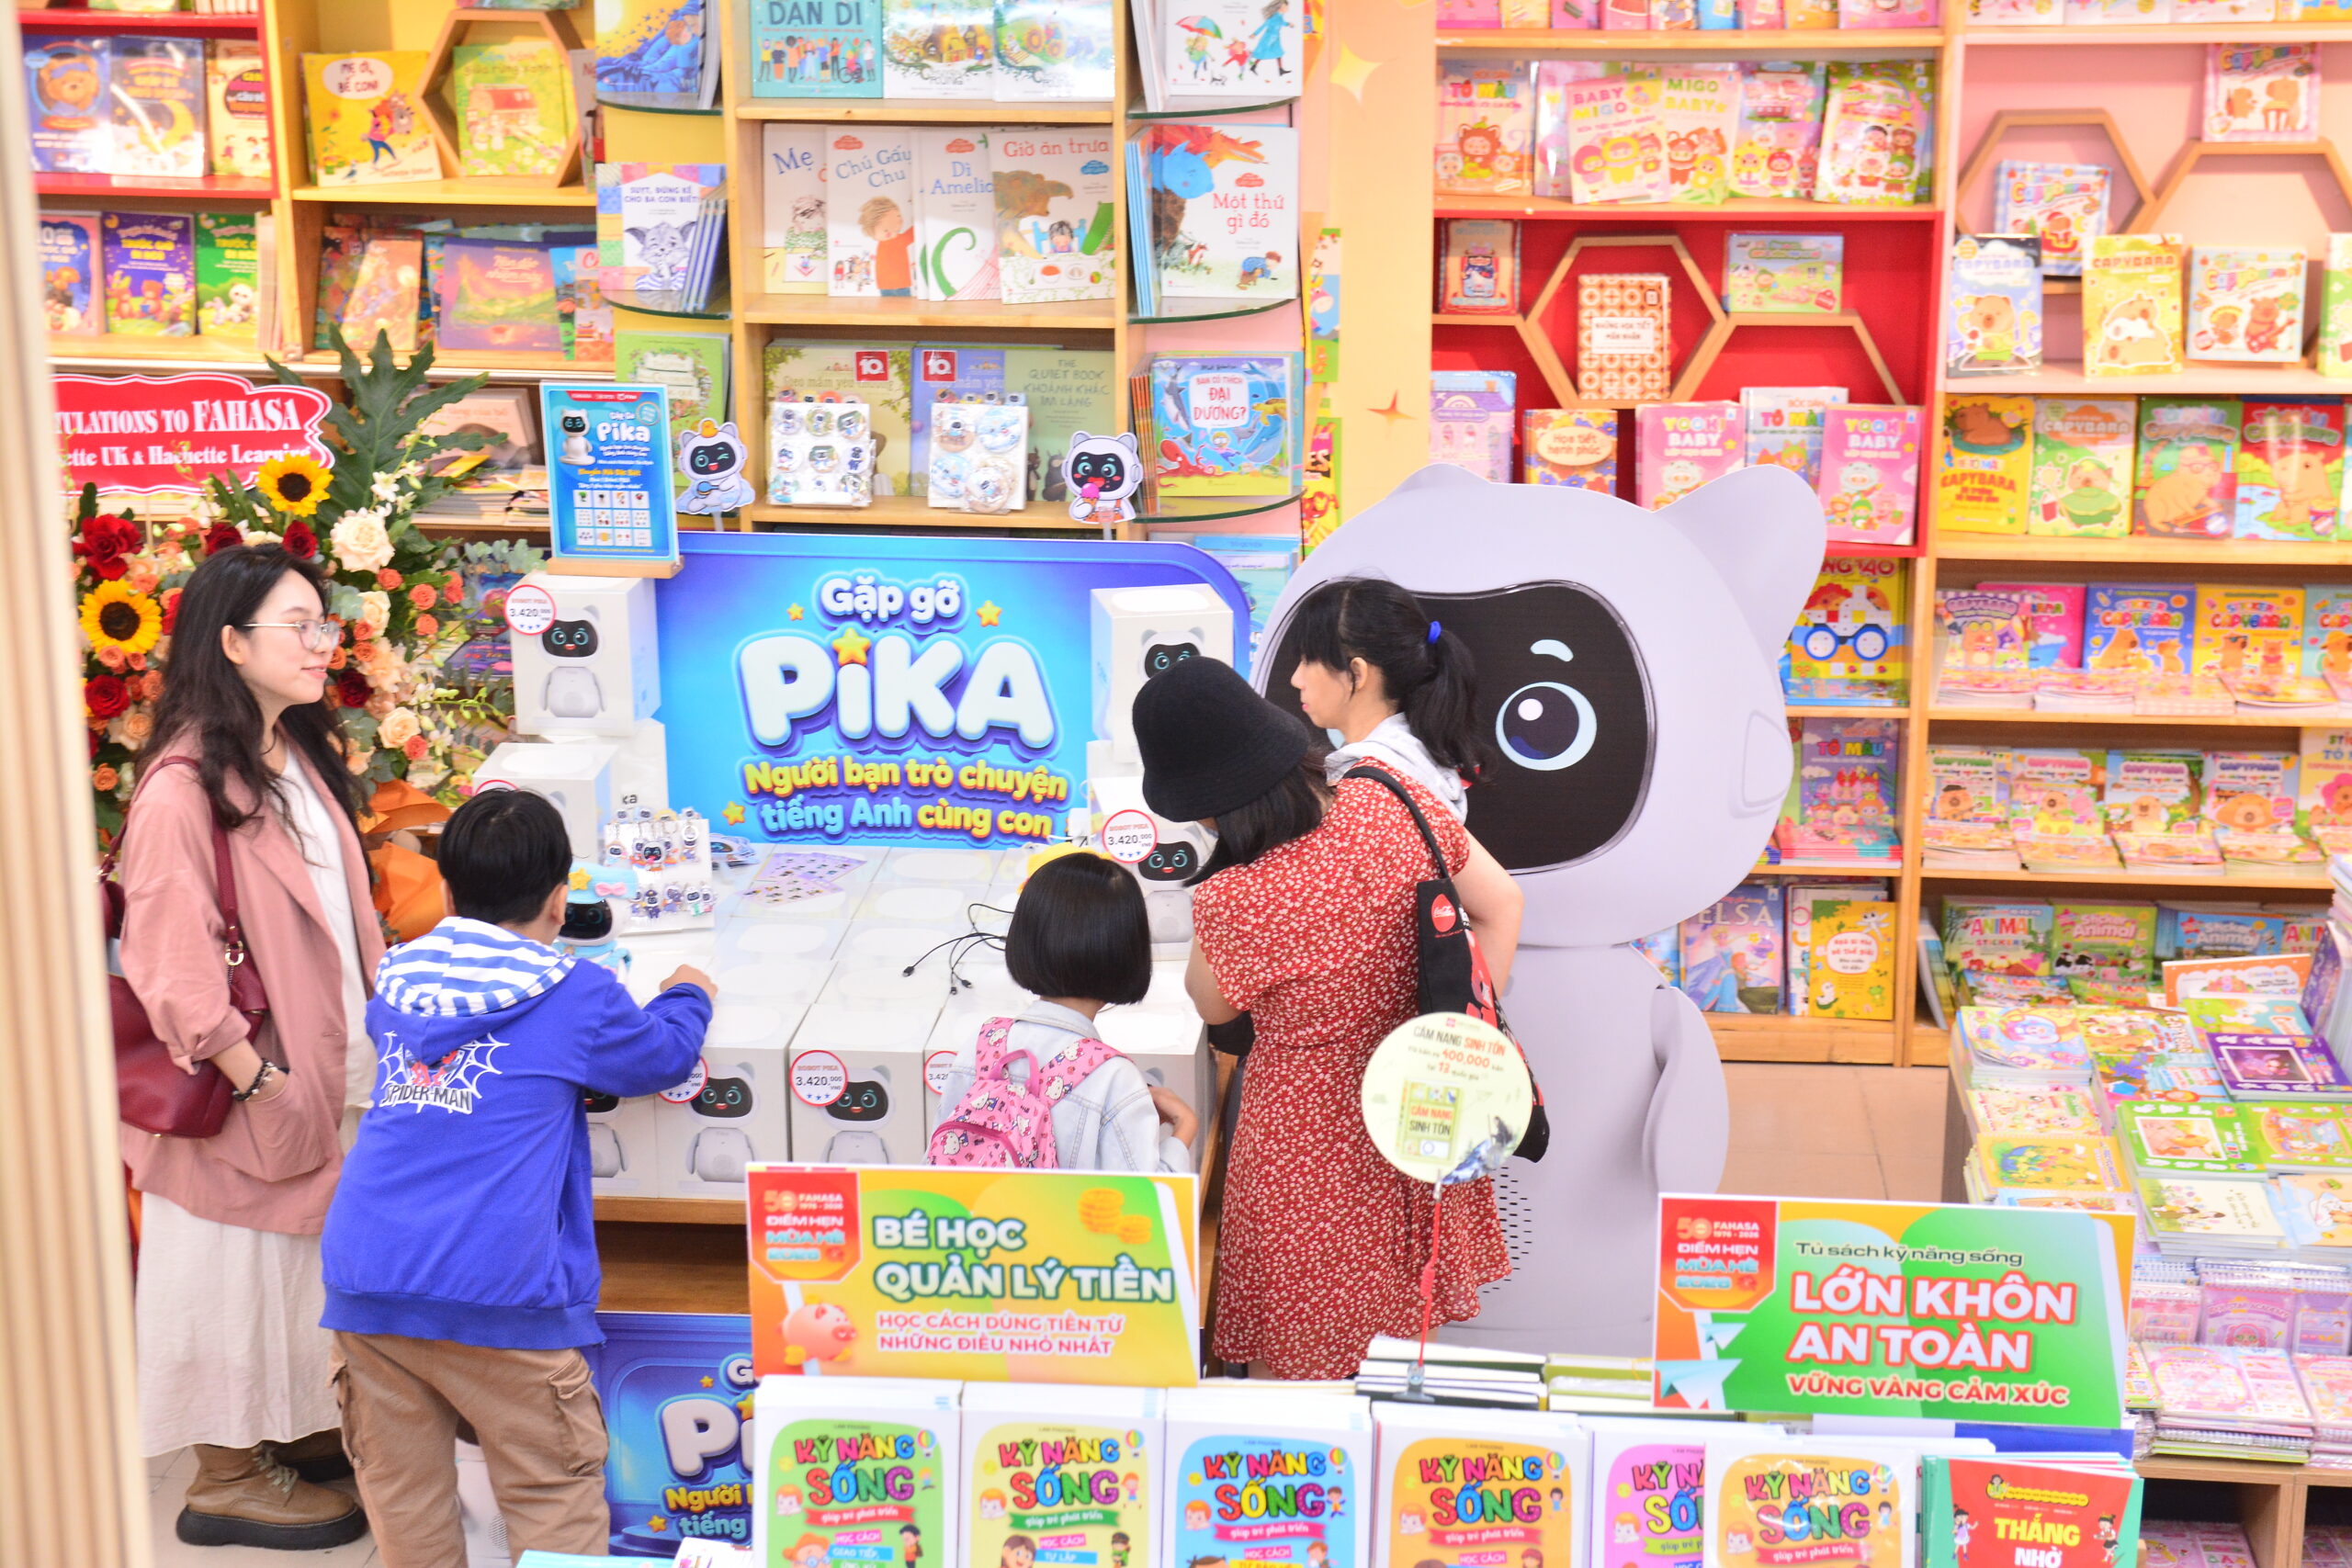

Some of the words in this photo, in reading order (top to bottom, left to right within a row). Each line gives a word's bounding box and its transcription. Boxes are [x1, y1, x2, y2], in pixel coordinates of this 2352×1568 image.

[1574, 87, 1623, 106] BABY
[1667, 78, 1719, 93] MIGO
[1573, 102, 1627, 120] MIGO
[1664, 96, 1715, 112] BABY
[1003, 140, 1035, 159] Giờ
[1041, 140, 1063, 156] ăn
[1069, 139, 1109, 155] trưa
[773, 148, 813, 175] Mẹ
[836, 155, 872, 179] Chú
[952, 160, 972, 177] Dì
[867, 167, 907, 188] Chu
[1213, 193, 1250, 211] Một
[1252, 191, 1285, 210] thứ
[1227, 214, 1245, 235] gì
[1249, 212, 1270, 229] đó
[2092, 255, 2175, 268] CAPYBARA
[1029, 368, 1069, 380] QUIET
[1072, 368, 1105, 380] BOOK
[1208, 387, 1231, 402] ĐẠI
[161, 410, 189, 433] TO
[191, 398, 302, 433] FAHASA
[1193, 405, 1247, 421] DƯƠNG?
[596, 422, 650, 443] Pika
[2043, 420, 2130, 434] CAPYBARA
[1668, 433, 1720, 447] BABY
[1848, 434, 1900, 448] BABY
[63, 447, 97, 466] ette
[100, 446, 130, 466] UK
[132, 450, 145, 466] &
[1940, 472, 2017, 492] CAPYBARA
[820, 574, 905, 625] Gặp
[909, 578, 961, 625] gỡ
[2101, 612, 2184, 628] CAPYBARA
[2211, 613, 2291, 629] CAPYBARA
[1816, 739, 1841, 757] TÔ
[742, 755, 839, 797] Người
[842, 755, 901, 794] bạn
[904, 757, 954, 789] trò
[957, 759, 1069, 804] chuyện
[760, 795, 844, 836] tiếng
[850, 796, 913, 829] Anh
[916, 797, 992, 839] cùng
[997, 808, 1052, 839] con
[1697, 902, 1775, 928] ELSA
[2073, 923, 2137, 940] Animal
[2196, 931, 2260, 948] Animal
[1436, 1029, 1463, 1047] NANG
[1464, 1035, 1487, 1053] SINH
[1487, 1038, 1506, 1056] TỒN
[1442, 1048, 1490, 1069] 400.000
[381, 1084, 471, 1111] SPIDER-MAN
[1409, 1120, 1430, 1133] SINH
[798, 1193, 843, 1202] FAHASA
[809, 1215, 844, 1228] HẸN
[1713, 1221, 1759, 1231] FAHASA
[873, 1208, 931, 1248] BÉ
[935, 1214, 1026, 1259] HỌC
[1722, 1244, 1759, 1257] HẸN
[1796, 1240, 1825, 1258] Tủ
[1826, 1241, 1881, 1259] sách
[1883, 1245, 1910, 1264] kỹ
[1912, 1245, 1966, 1265] năng
[1969, 1247, 2023, 1267] sống
[873, 1252, 1005, 1303] QUẢN
[1011, 1255, 1069, 1300] LÝ
[1070, 1250, 1176, 1303] TIỀN
[1791, 1261, 1905, 1316] LỚN
[1911, 1271, 2078, 1325] KHÔN
[879, 1313, 922, 1332] HỌC
[925, 1310, 981, 1331] CÁCH
[984, 1312, 1043, 1332] DÙNG
[1046, 1312, 1096, 1333] TIỀN
[1097, 1314, 1125, 1334] TỪ
[879, 1332, 955, 1352] NHỮNG
[956, 1332, 1005, 1353] ĐIỀU
[1009, 1332, 1056, 1354] NHỎ
[1057, 1333, 1114, 1355] NHẤT
[1784, 1320, 1871, 1366] AN
[1877, 1320, 2033, 1374] TOÀN
[1788, 1369, 1863, 1397] VỮNG
[1869, 1374, 1943, 1401] VÀNG
[1945, 1377, 2009, 1404] CẢM
[2010, 1380, 2070, 1407] XÚC
[795, 1432, 831, 1465] KỸ
[836, 1432, 915, 1462] NĂNG
[999, 1437, 1037, 1469] KỸ
[1041, 1435, 1120, 1465] NĂNG
[1204, 1452, 1239, 1481] KỸ
[1245, 1449, 1327, 1477] NĂNG
[1419, 1455, 1457, 1483] KỸ
[1462, 1452, 1543, 1482] NĂNG
[806, 1462, 915, 1506] SỐNG
[1010, 1464, 1120, 1509] SỐNG
[1632, 1462, 1671, 1493] KỸ
[1744, 1469, 1784, 1502] KỸ
[1789, 1467, 1870, 1497] NĂNG
[664, 1482, 742, 1512] Người
[1214, 1478, 1326, 1521] SỐNG
[1430, 1479, 1542, 1527] SỐNG
[679, 1511, 747, 1539] tiếng
[1756, 1496, 1871, 1544] SỐNG
[2014, 1546, 2063, 1568] NHỜ
